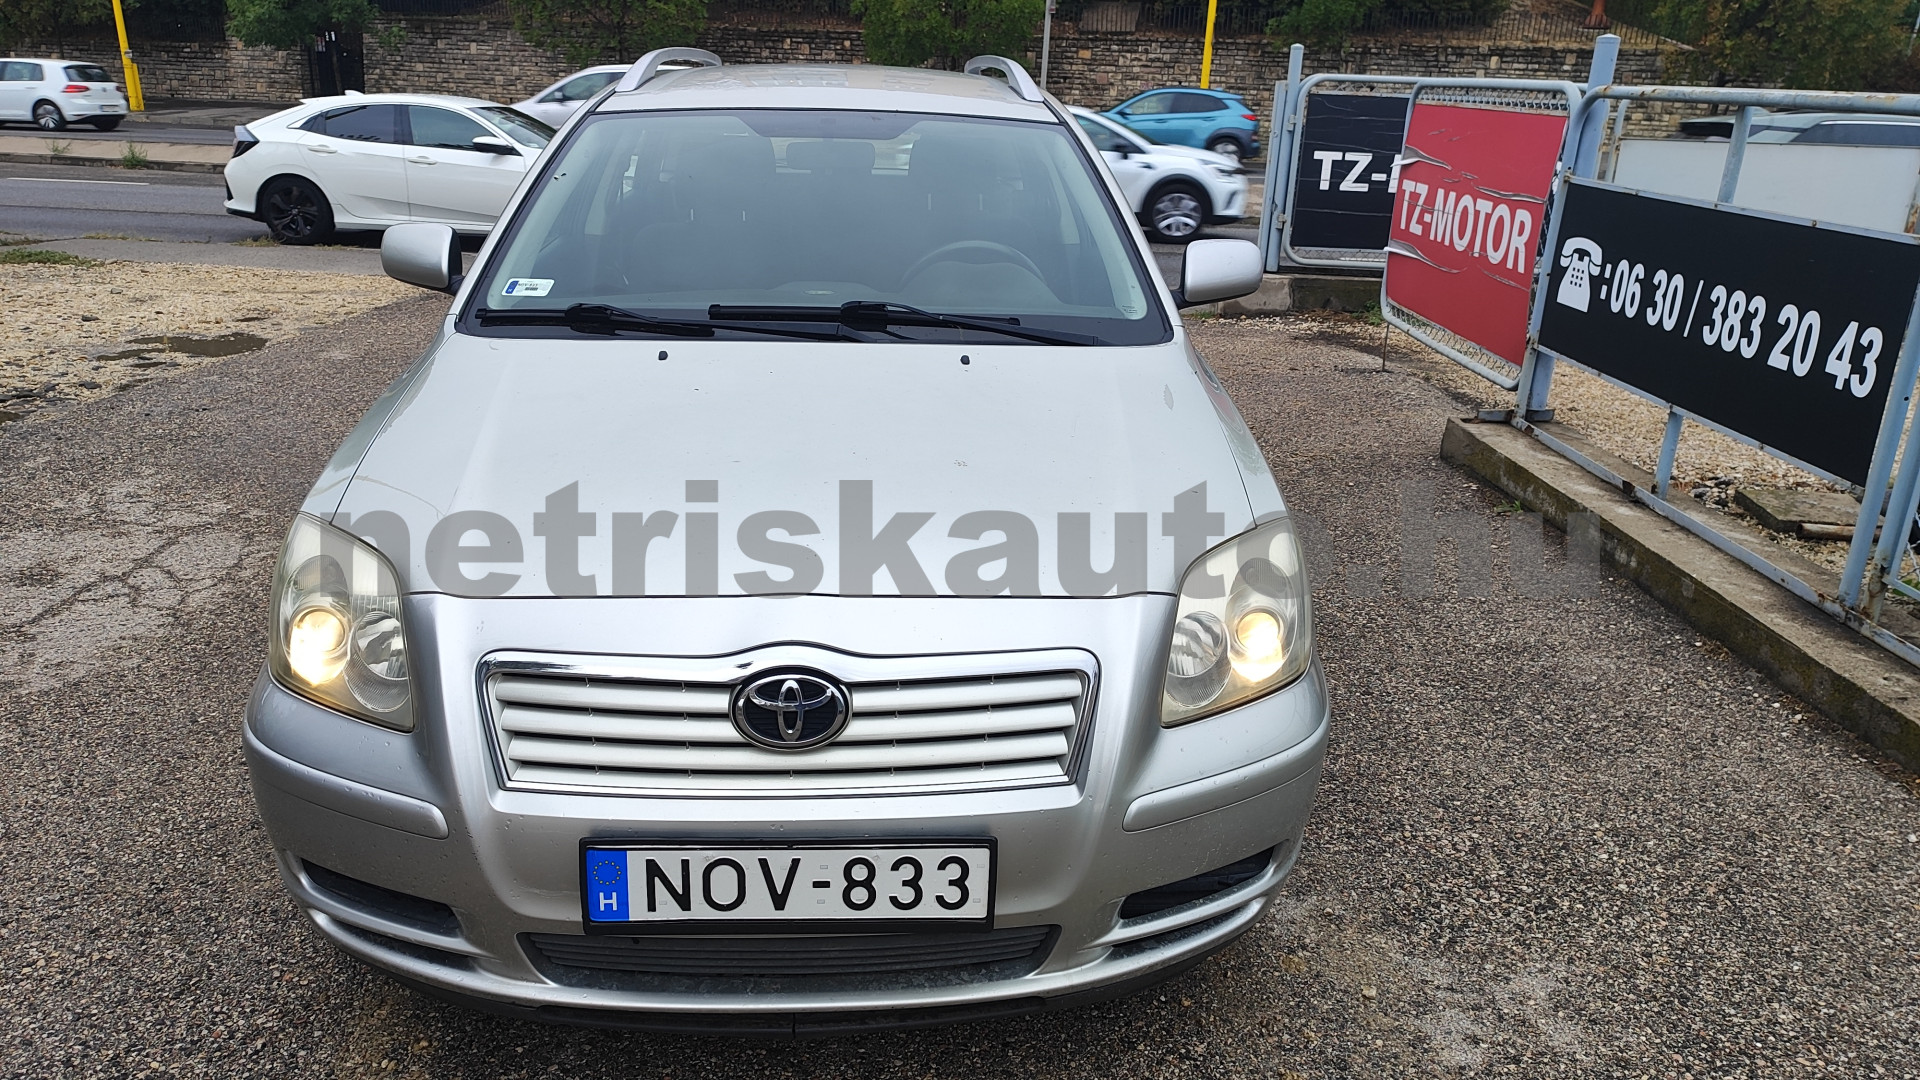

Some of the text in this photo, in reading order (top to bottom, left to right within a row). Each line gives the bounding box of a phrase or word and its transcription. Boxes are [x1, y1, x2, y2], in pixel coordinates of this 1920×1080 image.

[1400, 178, 1532, 274] TZ-MOTOR
[1646, 269, 1684, 331] 30
[1703, 284, 1767, 359] 383
[1767, 303, 1821, 377] 20
[1825, 320, 1883, 398] 43
[599, 892, 618, 912] H
[645, 855, 970, 912] NOV-833
